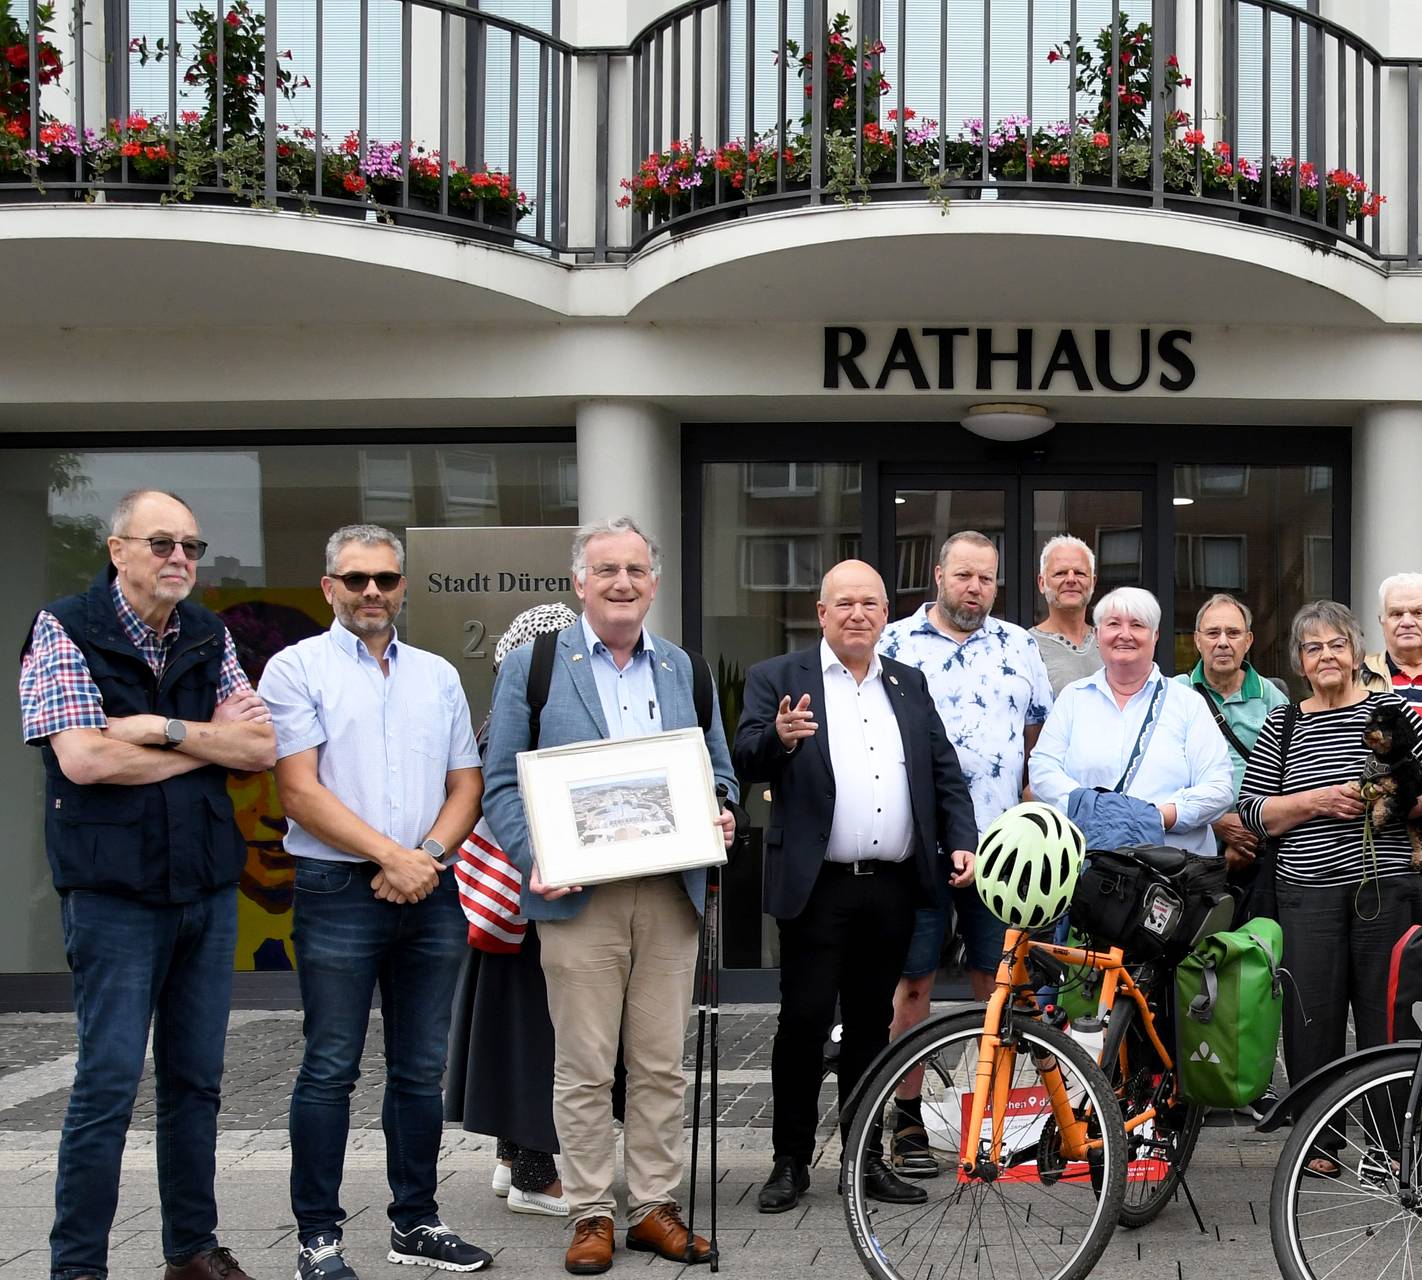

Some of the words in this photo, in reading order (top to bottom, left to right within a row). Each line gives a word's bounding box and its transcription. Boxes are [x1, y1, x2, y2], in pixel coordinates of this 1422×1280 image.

[823, 326, 1196, 392] RATHAUS
[428, 572, 491, 593] Stadt
[497, 572, 571, 593] Düren
[847, 1159, 873, 1259] SCHWALBE
